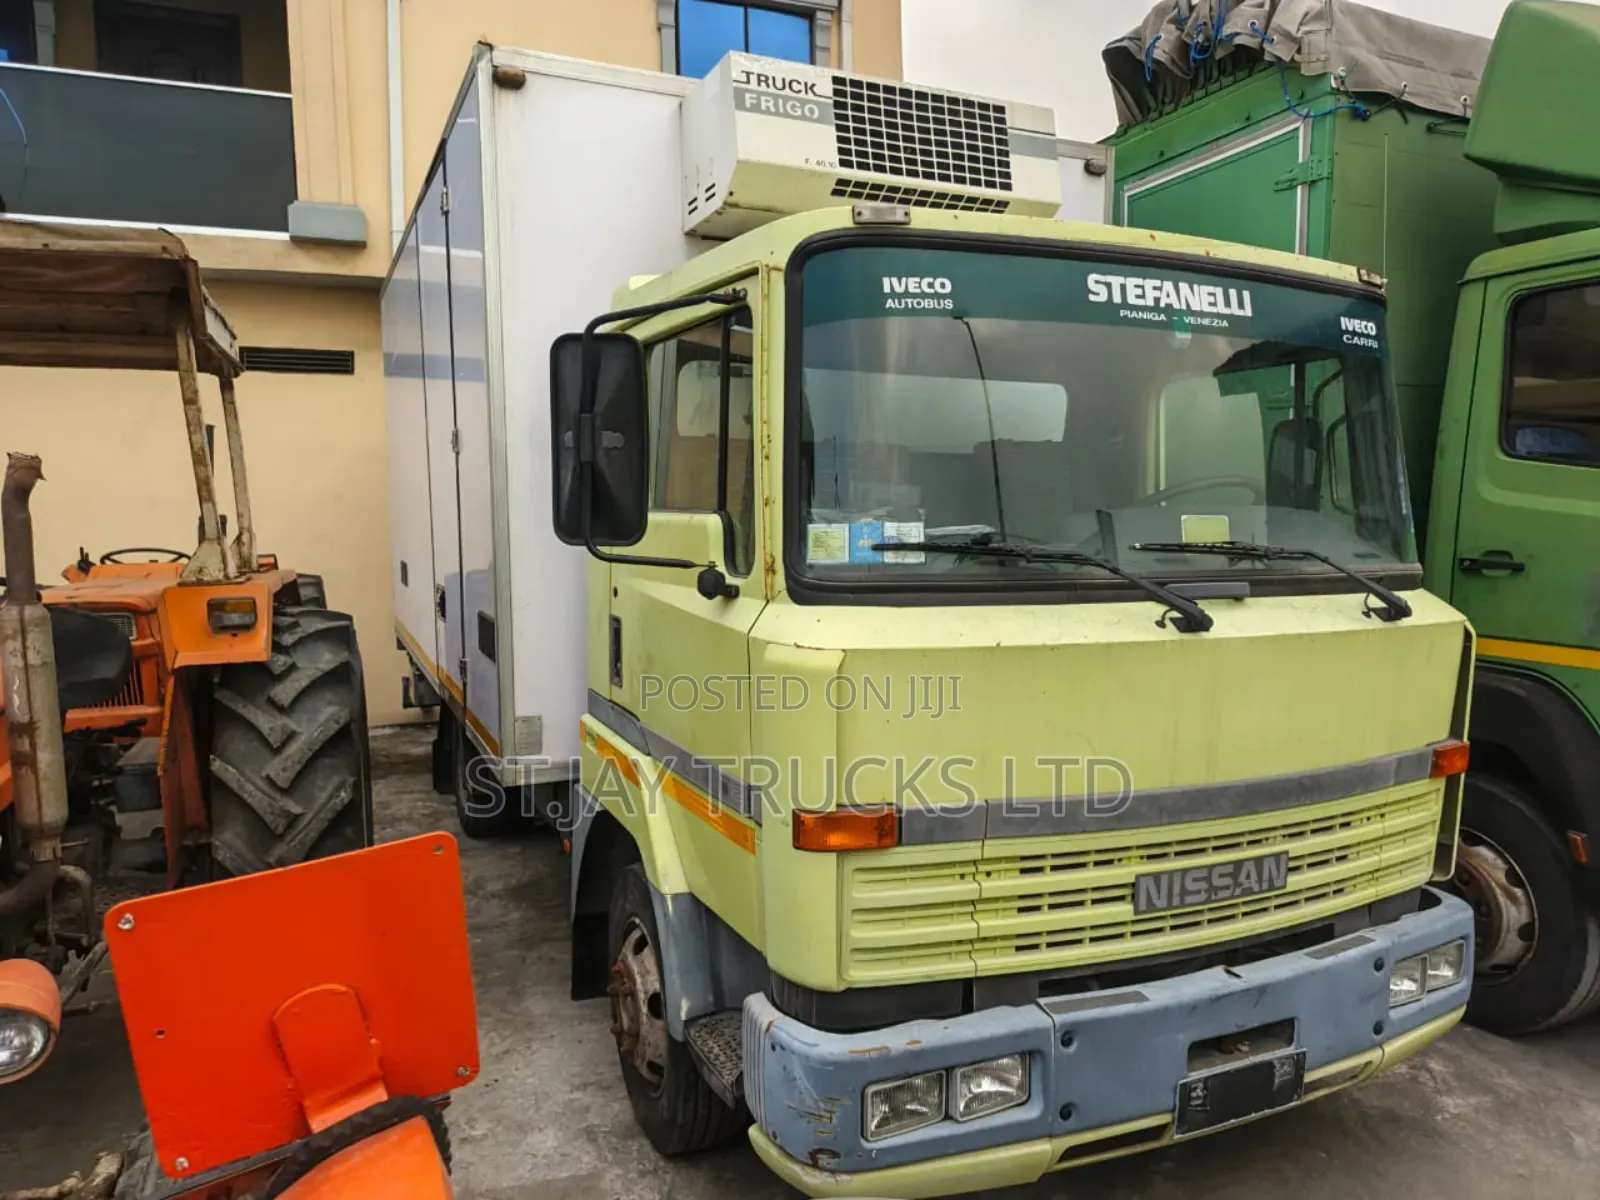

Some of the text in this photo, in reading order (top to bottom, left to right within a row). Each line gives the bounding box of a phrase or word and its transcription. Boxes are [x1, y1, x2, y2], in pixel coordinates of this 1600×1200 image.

[735, 70, 817, 97] TRUCK
[744, 93, 820, 119] FRIGO
[881, 276, 953, 294] IVECO
[1087, 273, 1252, 317] STEFANELLI
[885, 299, 954, 310] AUTOBUS
[1119, 309, 1167, 321] PIANIGA
[1183, 315, 1230, 328] VENEZIA
[1340, 316, 1376, 336] IVECO
[1343, 334, 1378, 349] CARRI
[1138, 852, 1288, 911] NISSAN
